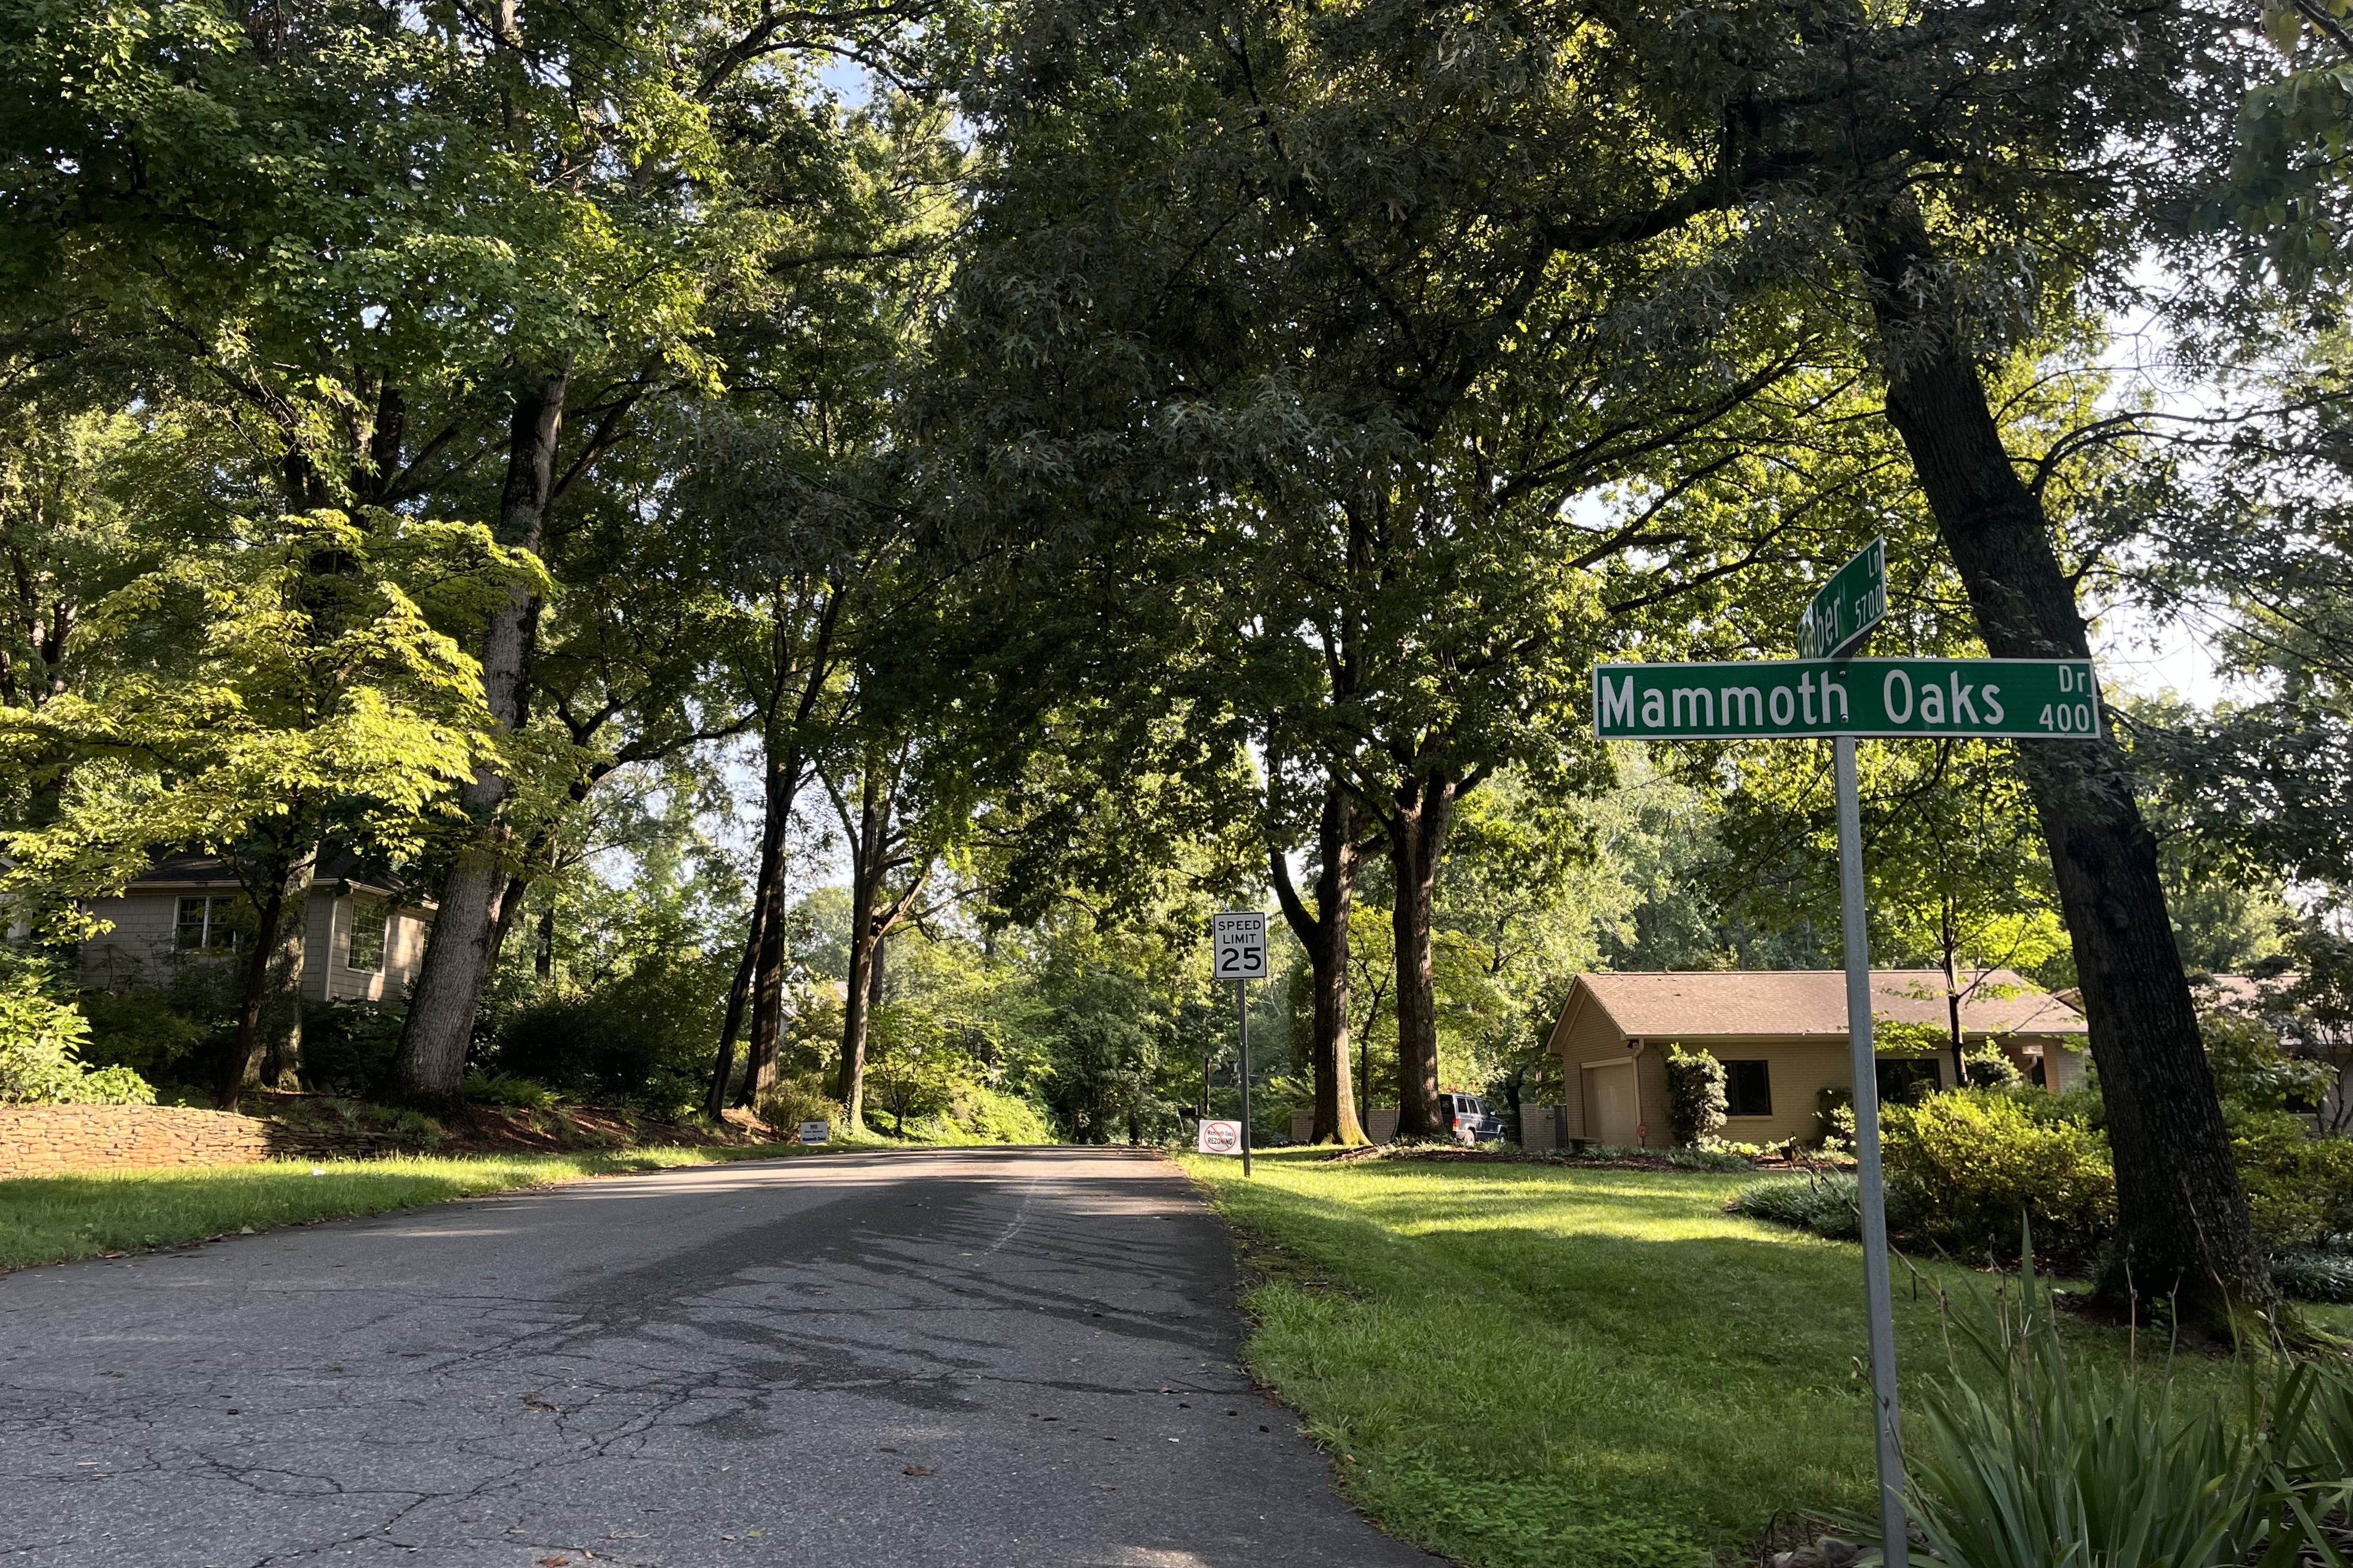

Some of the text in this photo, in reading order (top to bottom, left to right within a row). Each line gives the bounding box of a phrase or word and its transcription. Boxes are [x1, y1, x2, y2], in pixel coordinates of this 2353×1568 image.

[1867, 550, 1880, 578] Ln
[1855, 584, 1882, 629] 5700
[1602, 664, 2086, 729] Mammoth Oaks Dr
[2039, 702, 2090, 732] 400
[1218, 920, 1261, 931] SPEED
[1223, 934, 1256, 944] LIMIT
[1221, 947, 1262, 971] 25
